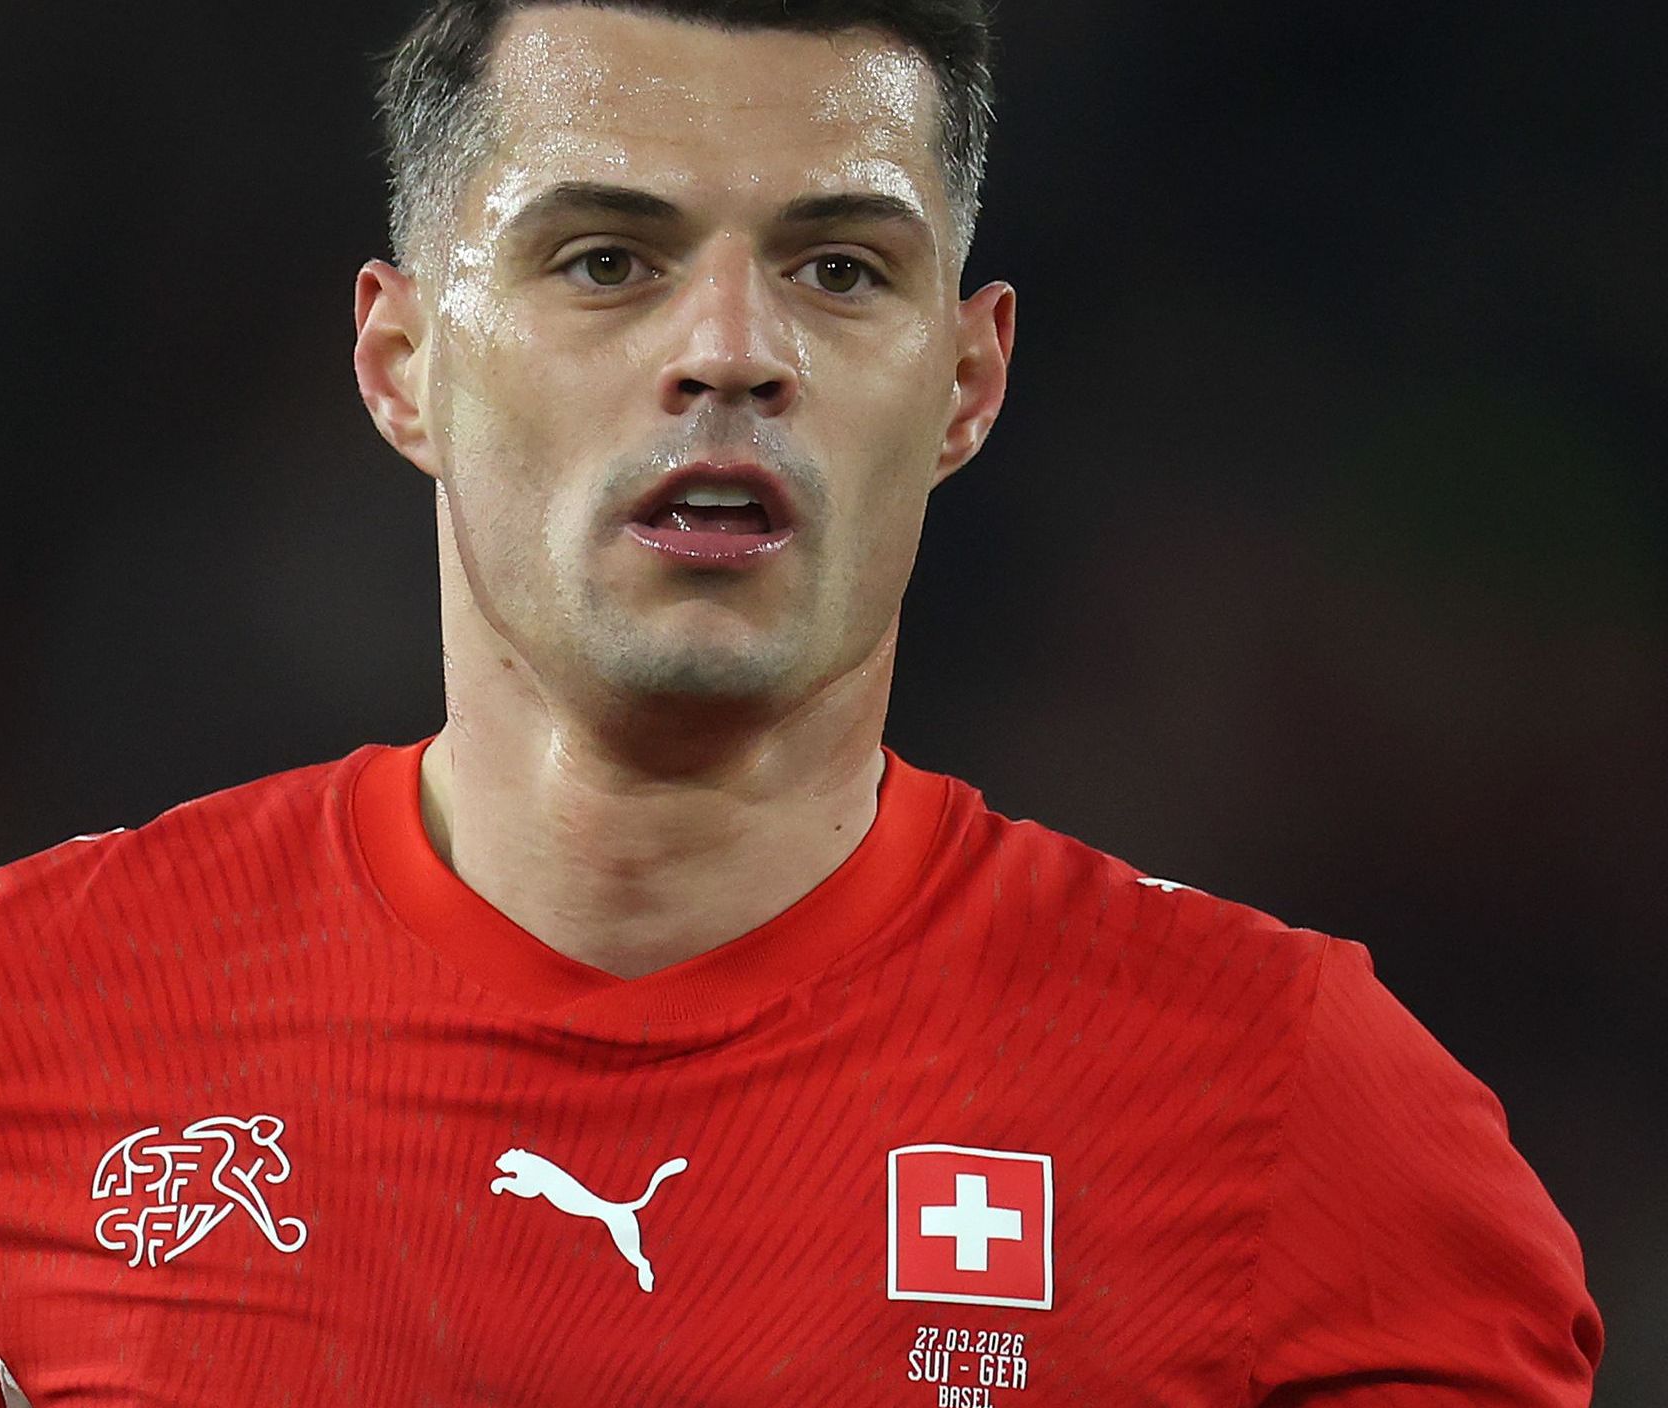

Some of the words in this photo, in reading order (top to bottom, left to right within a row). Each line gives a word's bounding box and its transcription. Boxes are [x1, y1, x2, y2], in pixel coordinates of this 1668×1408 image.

[914, 1326, 1025, 1357] 27.03.2026
[907, 1349, 950, 1383] SUI
[979, 1354, 1028, 1390] GER
